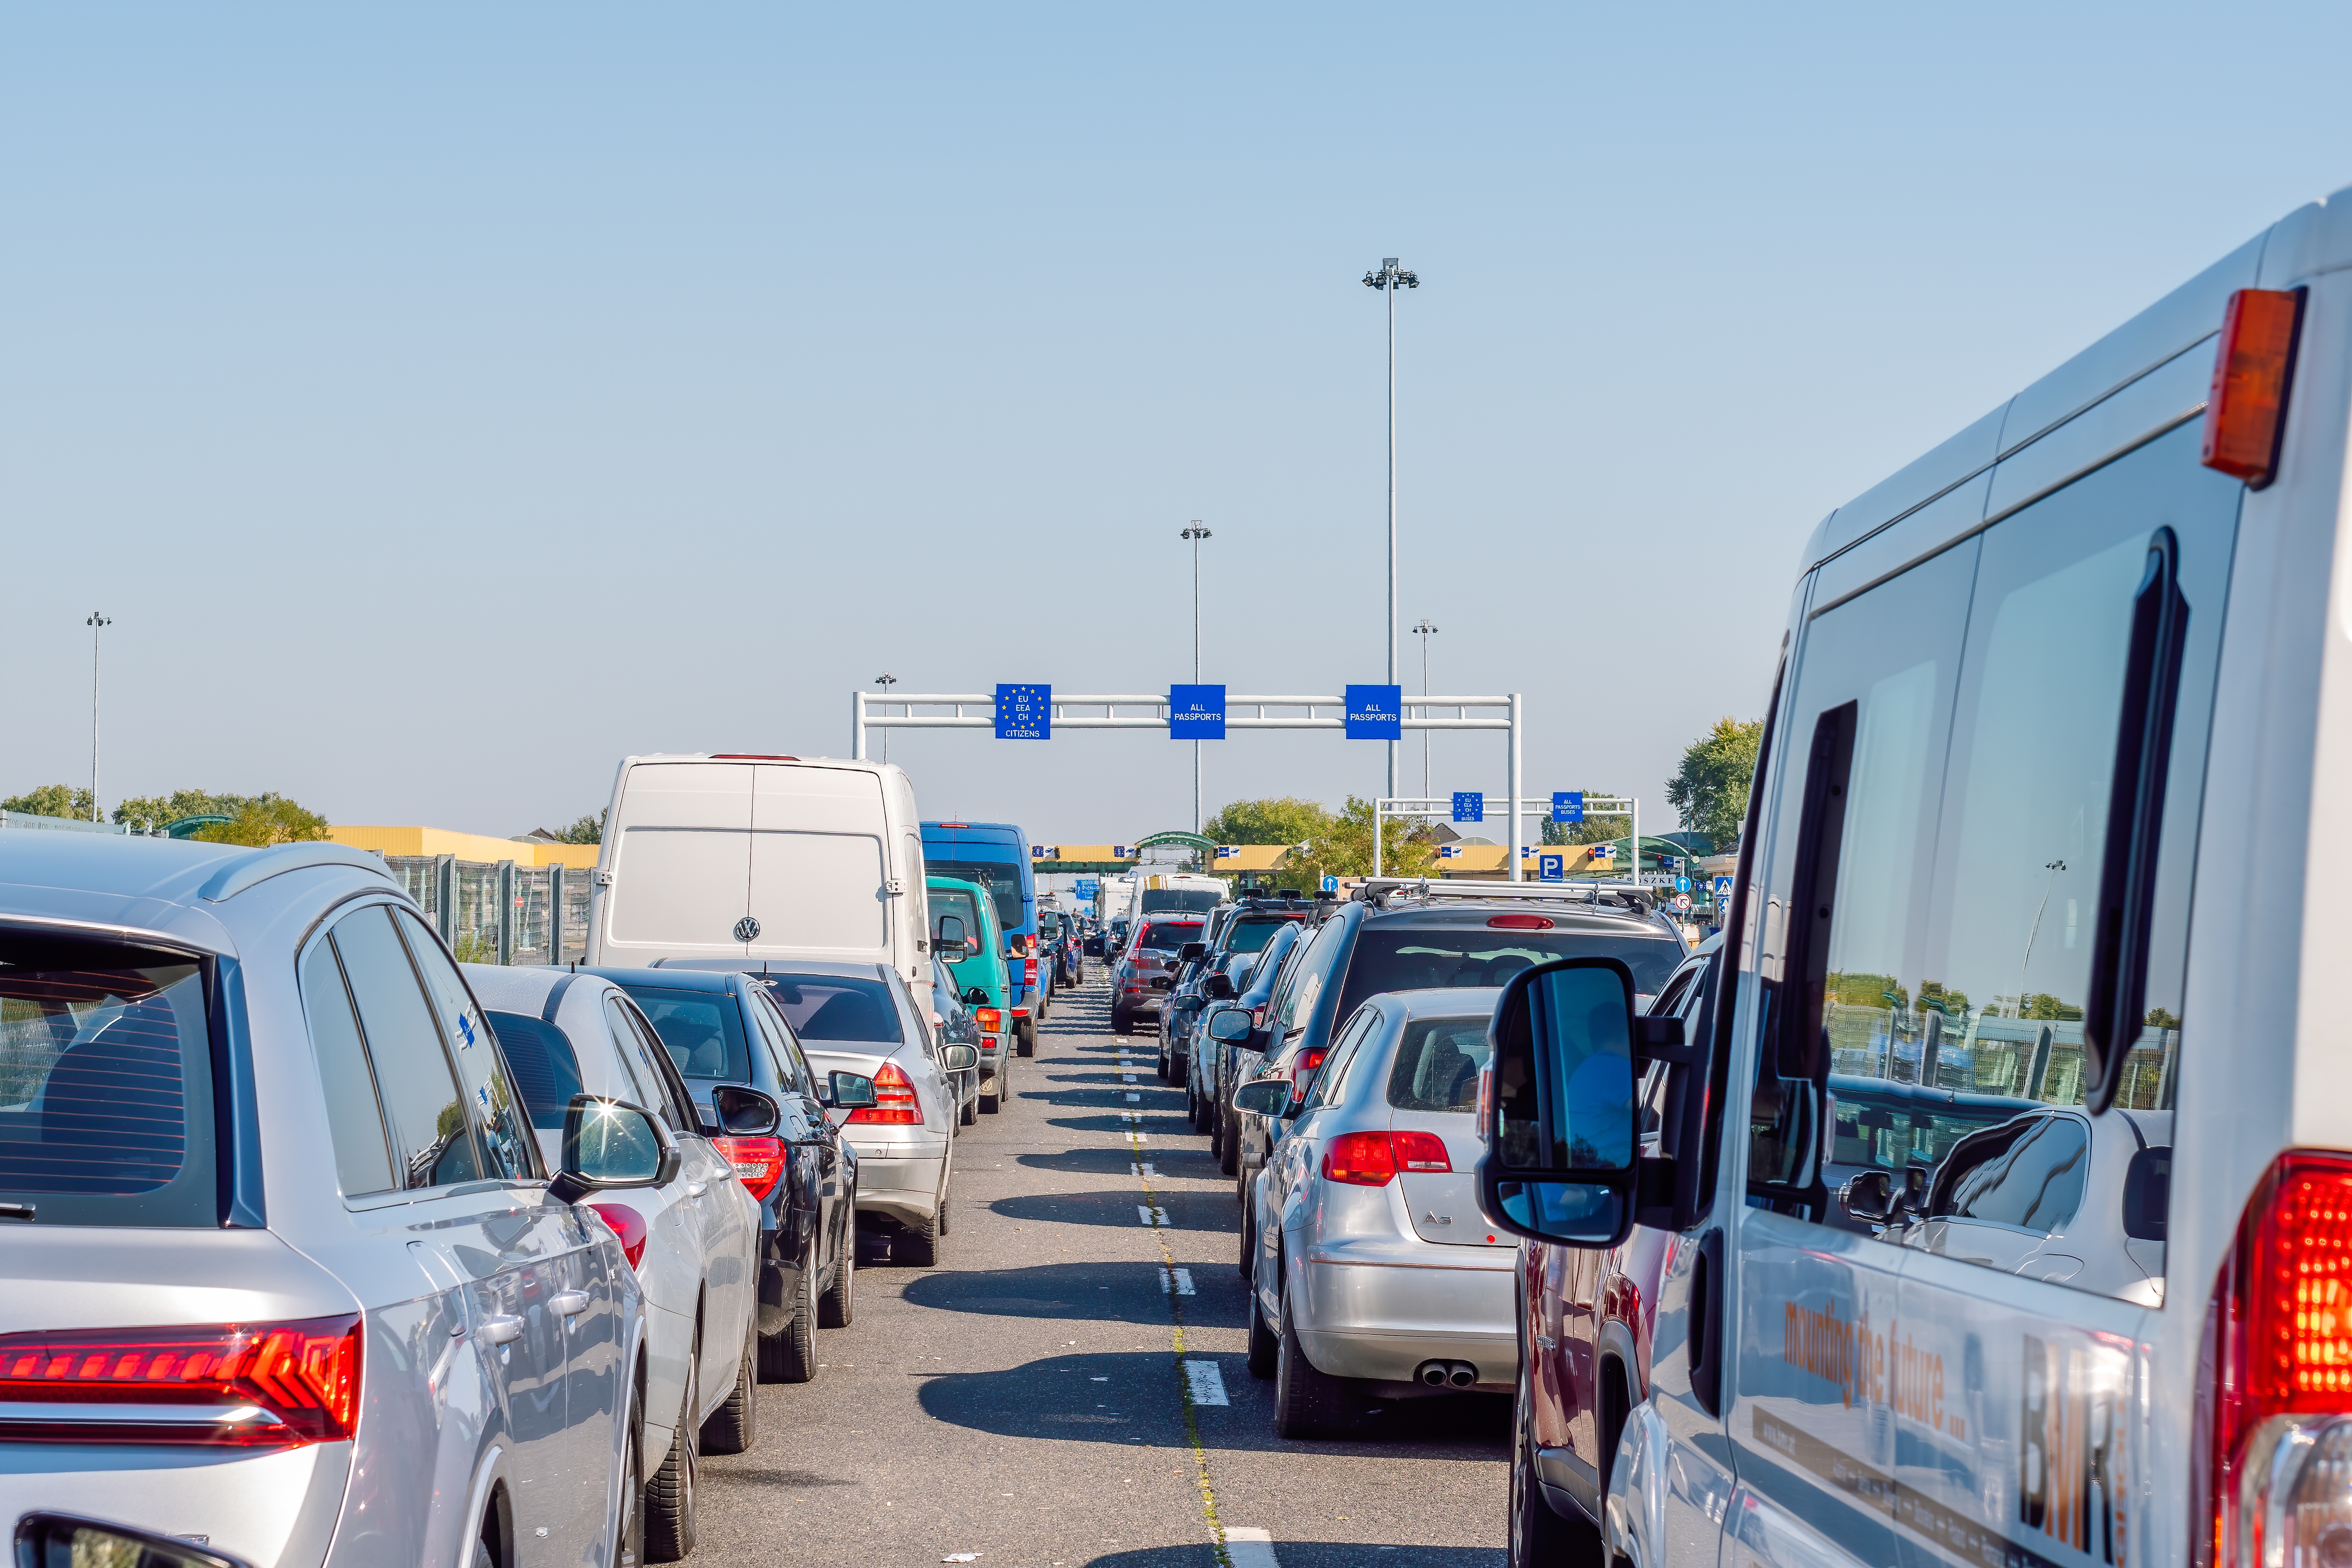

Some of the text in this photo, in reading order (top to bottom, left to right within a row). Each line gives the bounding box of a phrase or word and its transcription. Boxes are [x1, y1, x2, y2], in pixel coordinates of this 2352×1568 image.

[1544, 858, 1558, 876] P
[1422, 1210, 1453, 1225] A3
[1784, 1298, 1853, 1410] mounting
[1858, 1310, 1884, 1405] the
[1889, 1319, 1944, 1431] future
